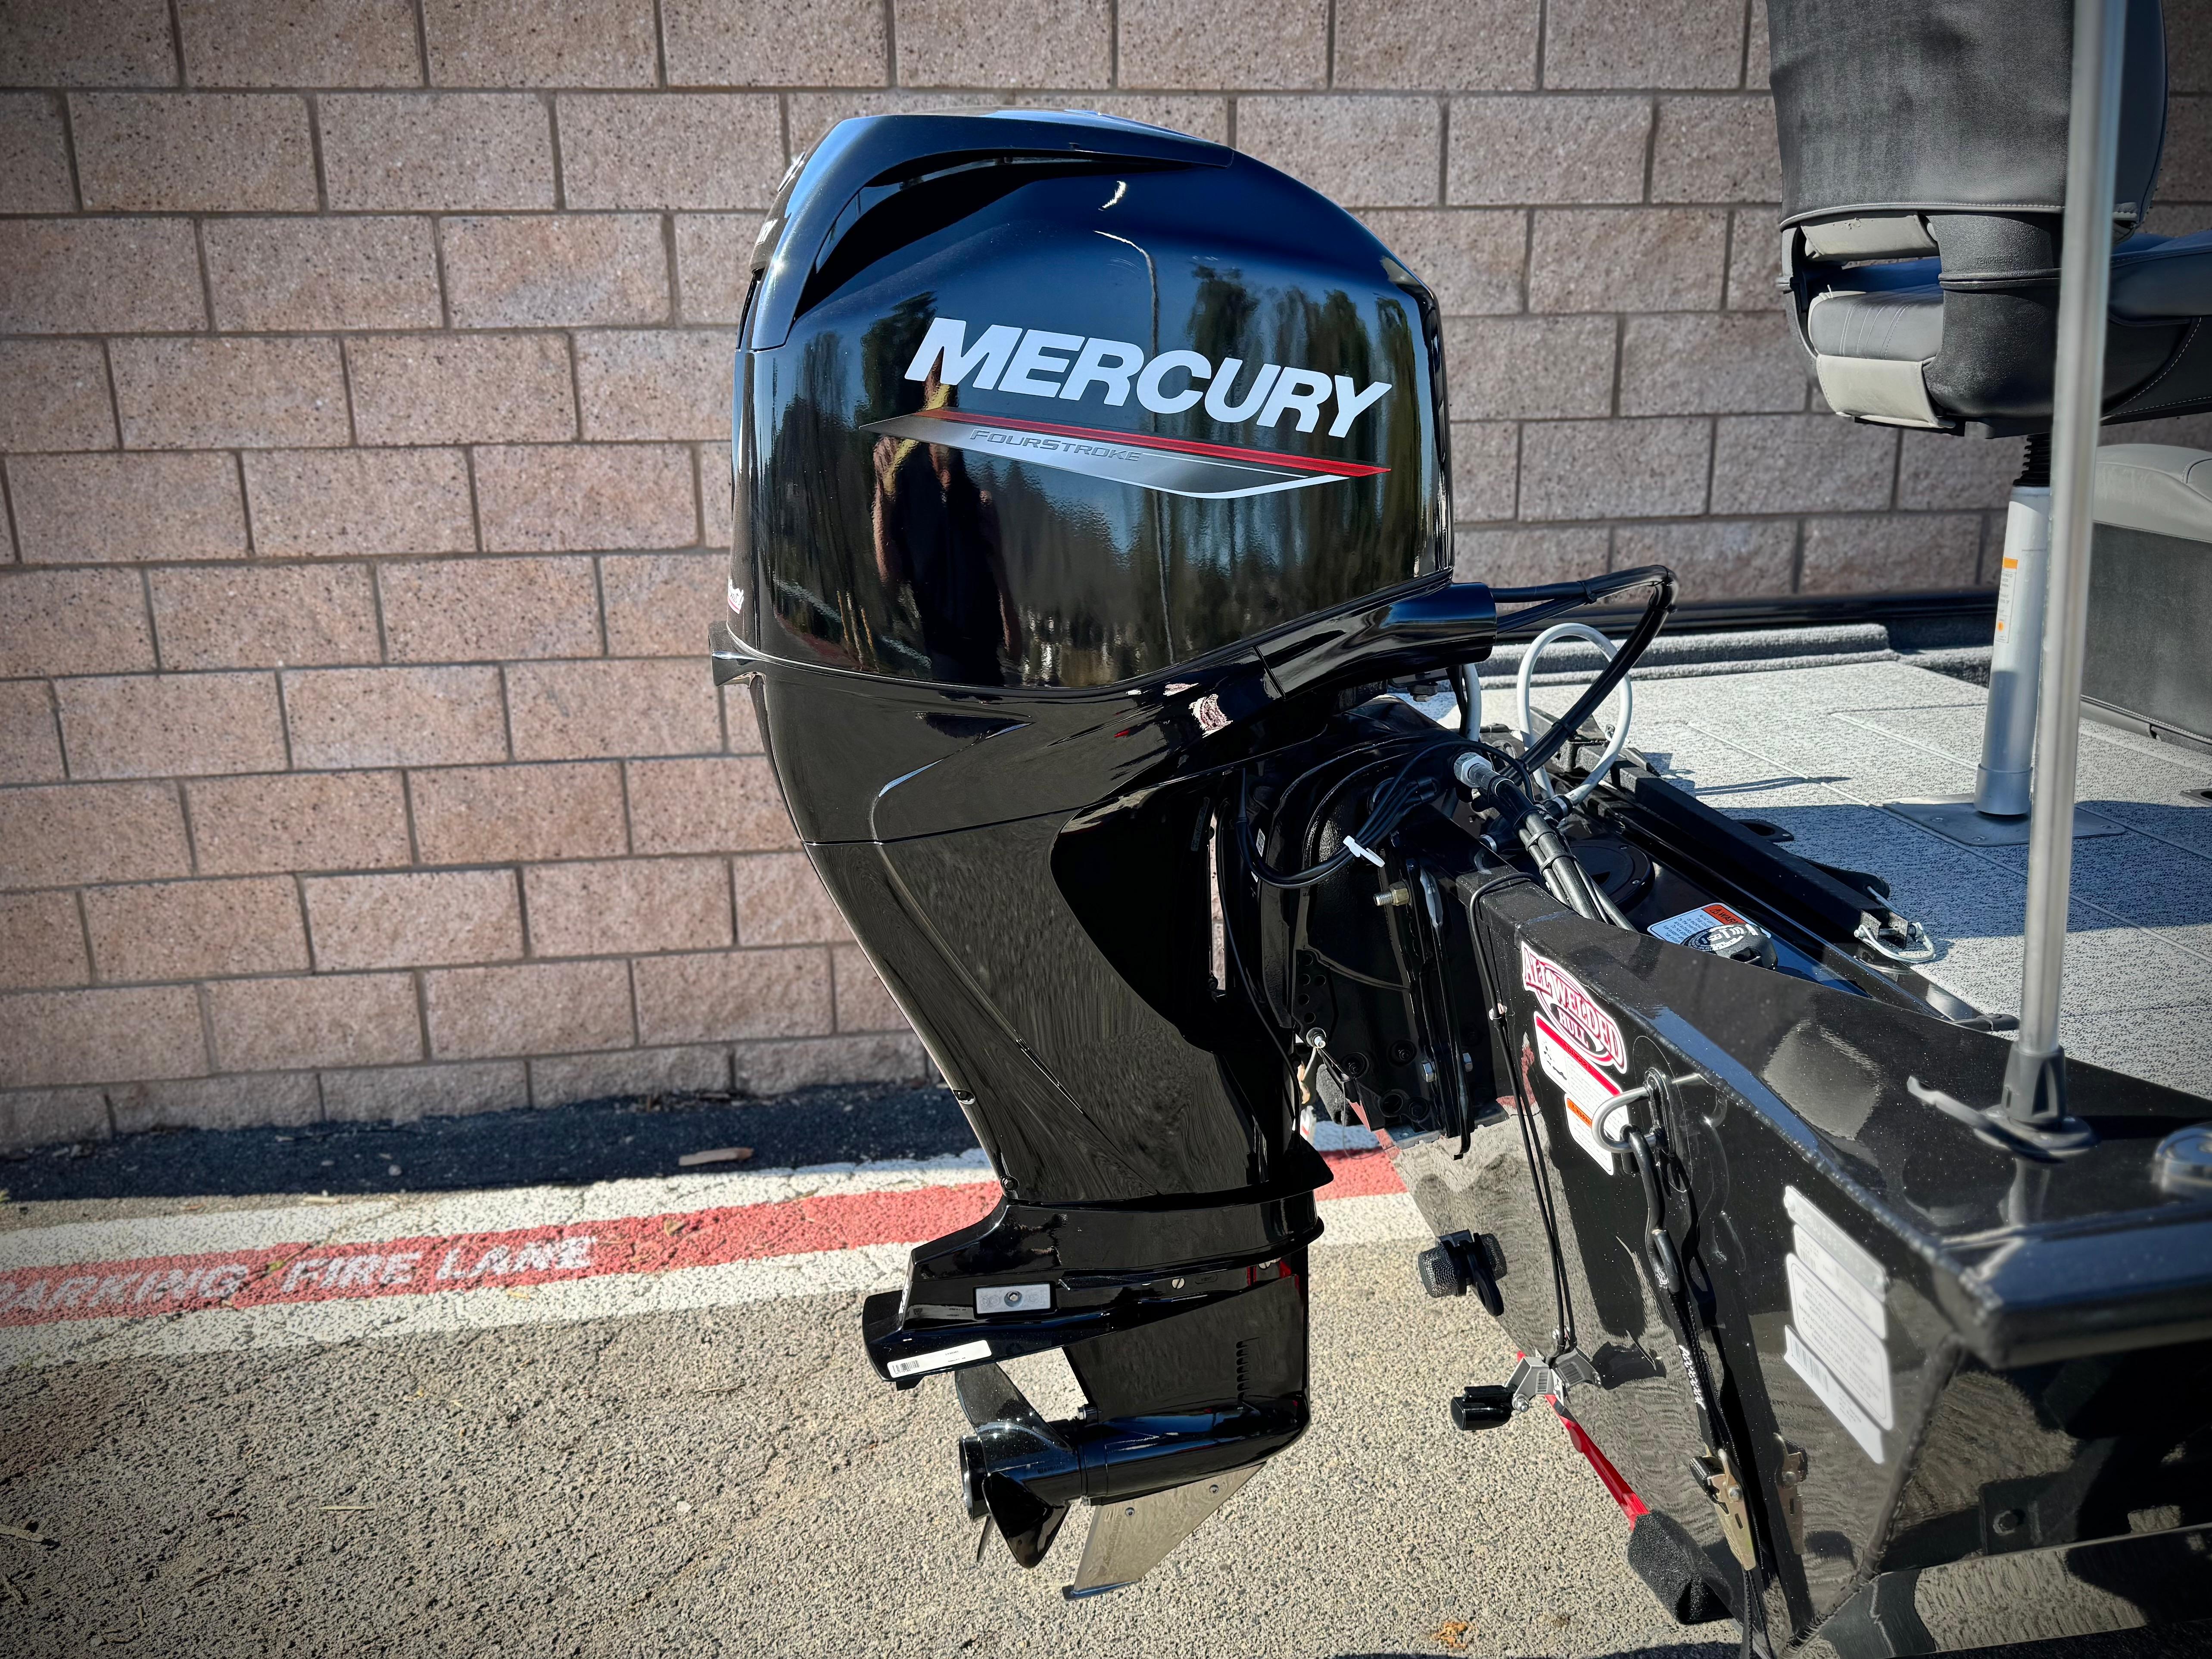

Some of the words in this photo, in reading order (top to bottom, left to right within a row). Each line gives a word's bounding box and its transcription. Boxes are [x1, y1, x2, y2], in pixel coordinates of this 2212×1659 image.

[904, 317, 1392, 438] MERCURY
[1524, 946, 1554, 999] ALL
[1550, 969, 1624, 1069] WELDED
[1557, 1007, 1590, 1050] HULL
[280, 1251, 422, 1292] FIRE
[436, 1236, 597, 1280] LANE
